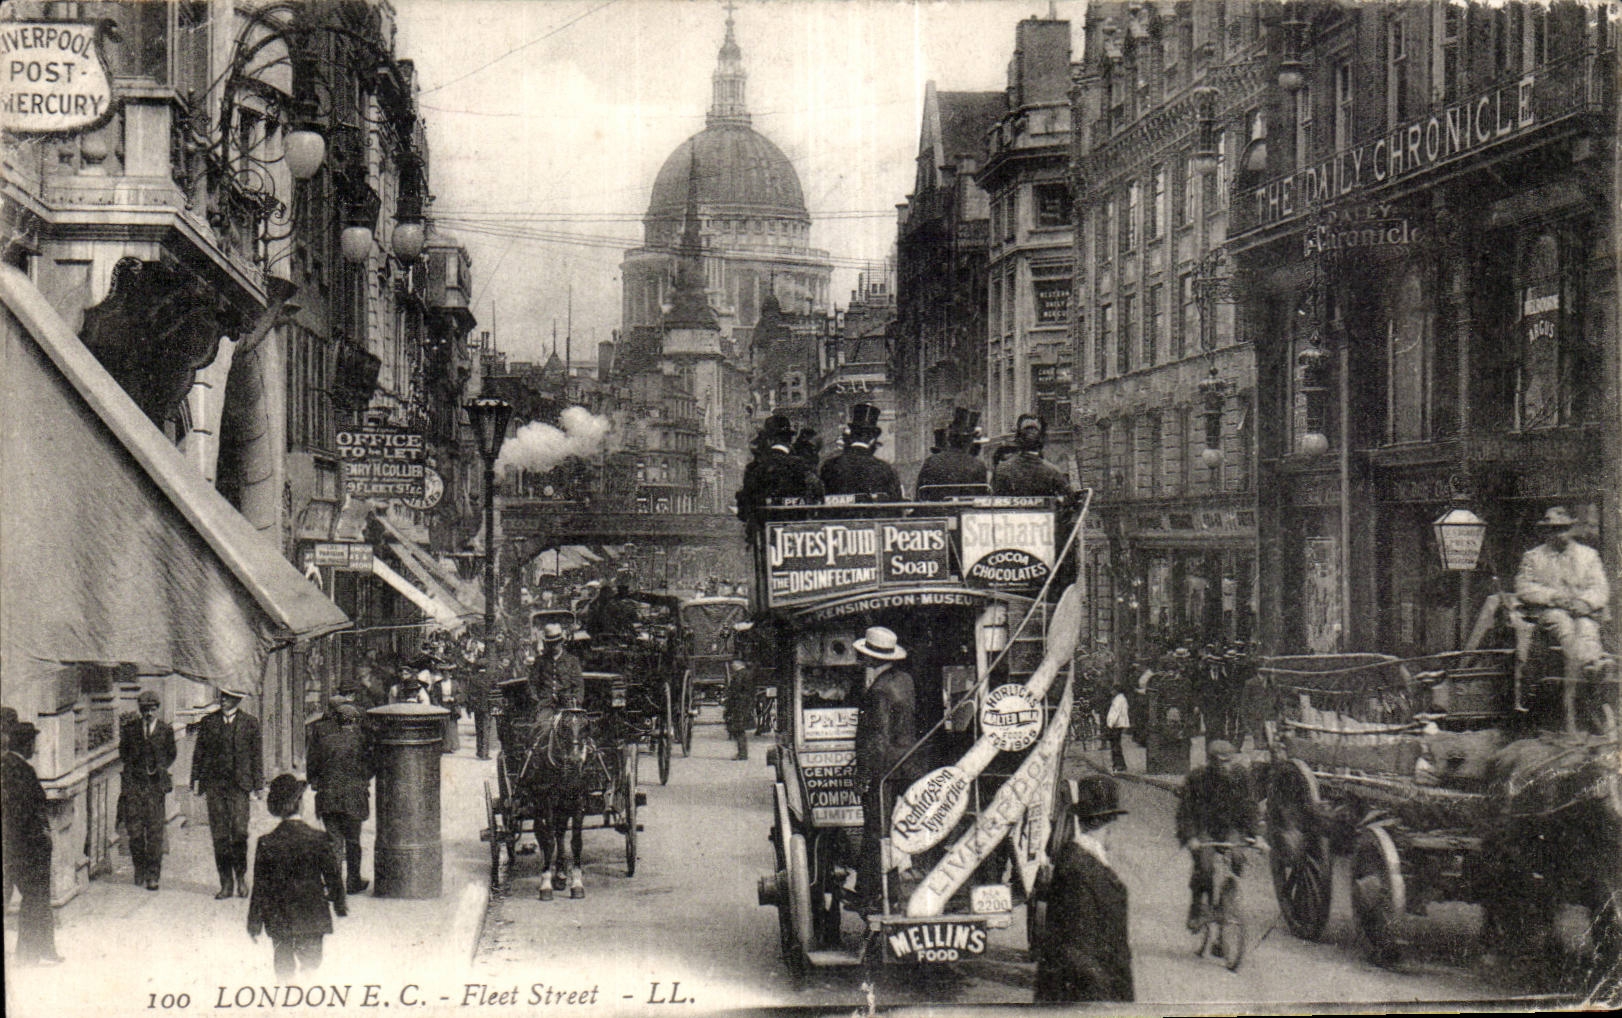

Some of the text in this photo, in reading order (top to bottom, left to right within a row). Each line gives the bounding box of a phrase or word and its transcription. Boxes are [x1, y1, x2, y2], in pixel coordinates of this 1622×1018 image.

[10, 61, 75, 83] POST
[1256, 76, 1535, 224] THE DAILY CHRONICLE
[1329, 203, 1391, 223] DAILY
[336, 431, 422, 447] OFFICE
[338, 446, 366, 458] TO
[384, 448, 421, 459] LET
[382, 464, 424, 477] COLLIER
[884, 525, 945, 552] Pears
[963, 516, 1054, 547] Suchard
[821, 526, 875, 566] FLUID
[891, 556, 938, 578] Soap
[988, 552, 1029, 566] COCOA
[772, 567, 876, 594] THE DISINFECTANT
[973, 563, 1047, 582] CHOCOLATES
[895, 769, 954, 839] Remington
[921, 779, 968, 833] Typewriter
[889, 924, 986, 958] MELLIN'S
[918, 949, 959, 963] FOOD
